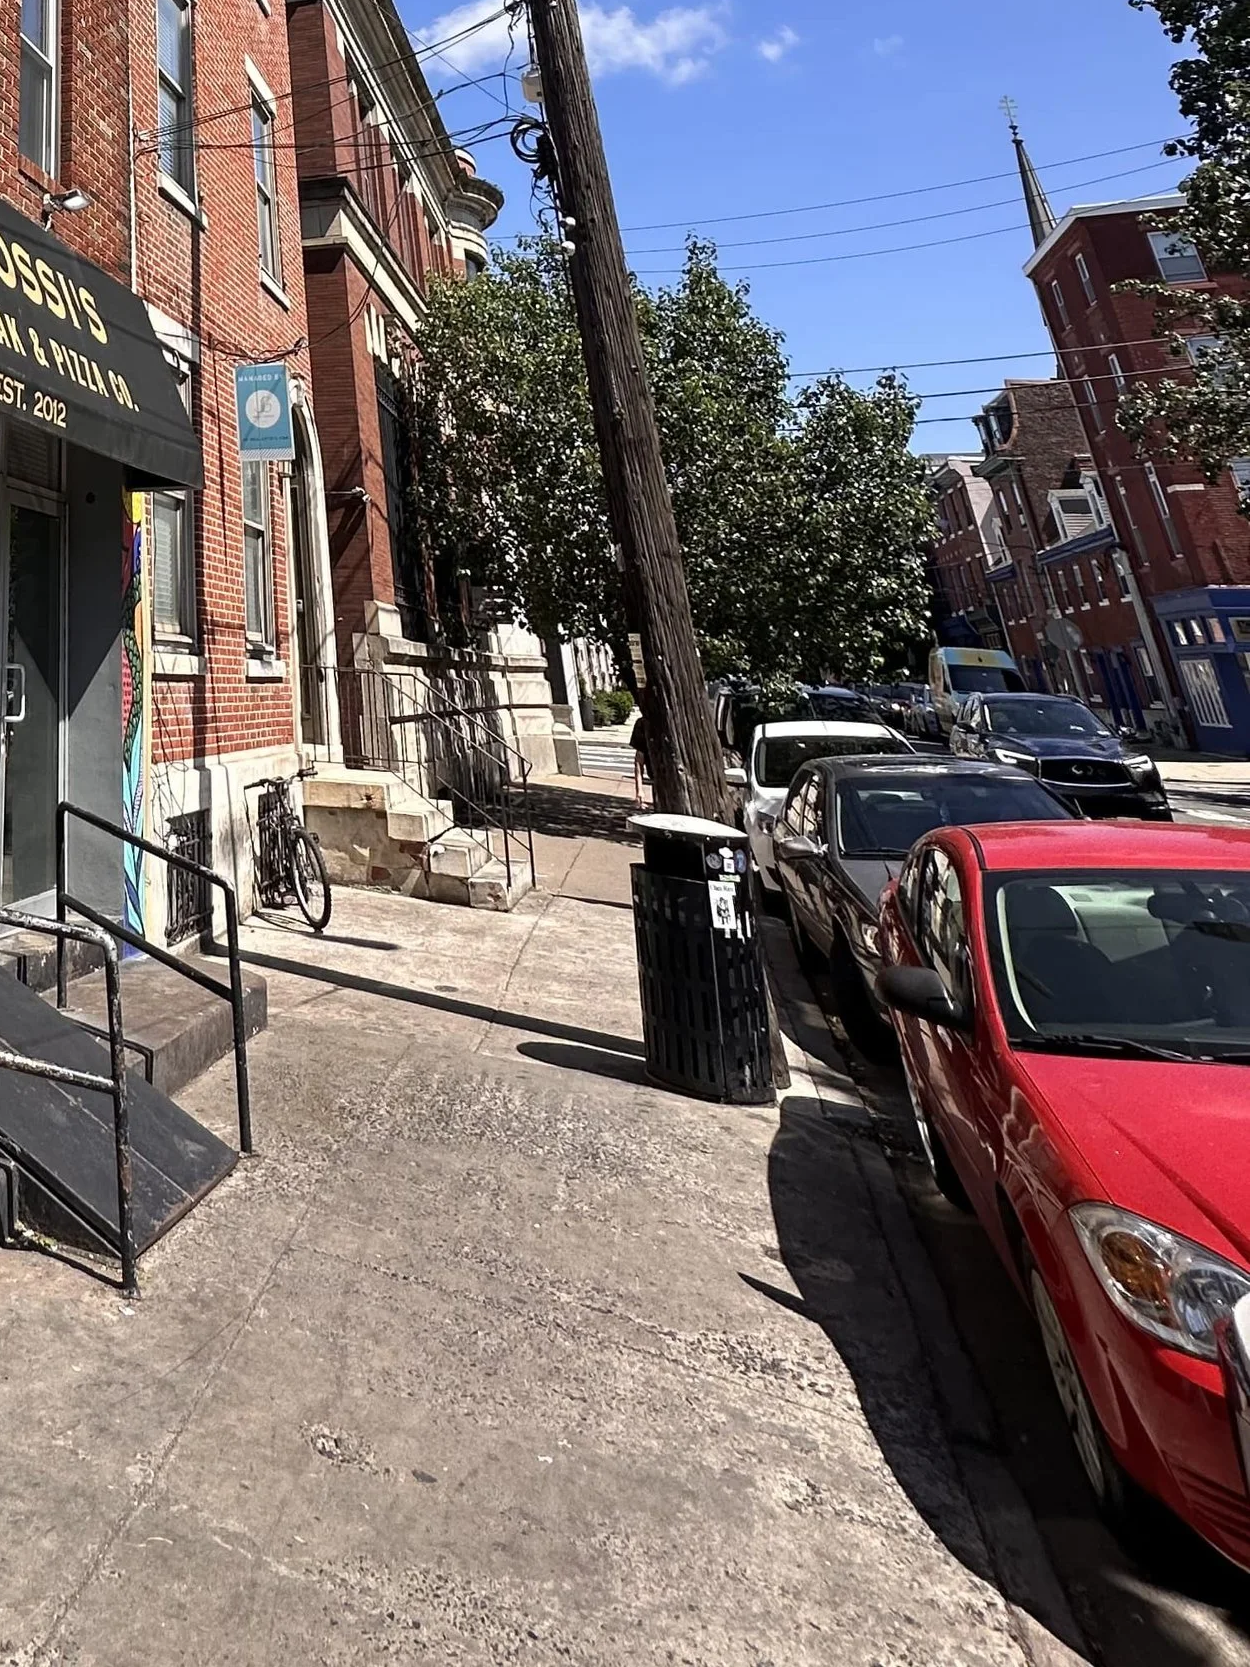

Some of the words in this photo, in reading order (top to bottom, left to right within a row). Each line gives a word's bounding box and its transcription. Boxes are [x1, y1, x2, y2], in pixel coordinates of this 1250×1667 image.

[27, 327, 50, 368] &
[50, 338, 109, 398] PIZZA
[107, 369, 140, 413] CO.
[33, 390, 68, 428] 2012
